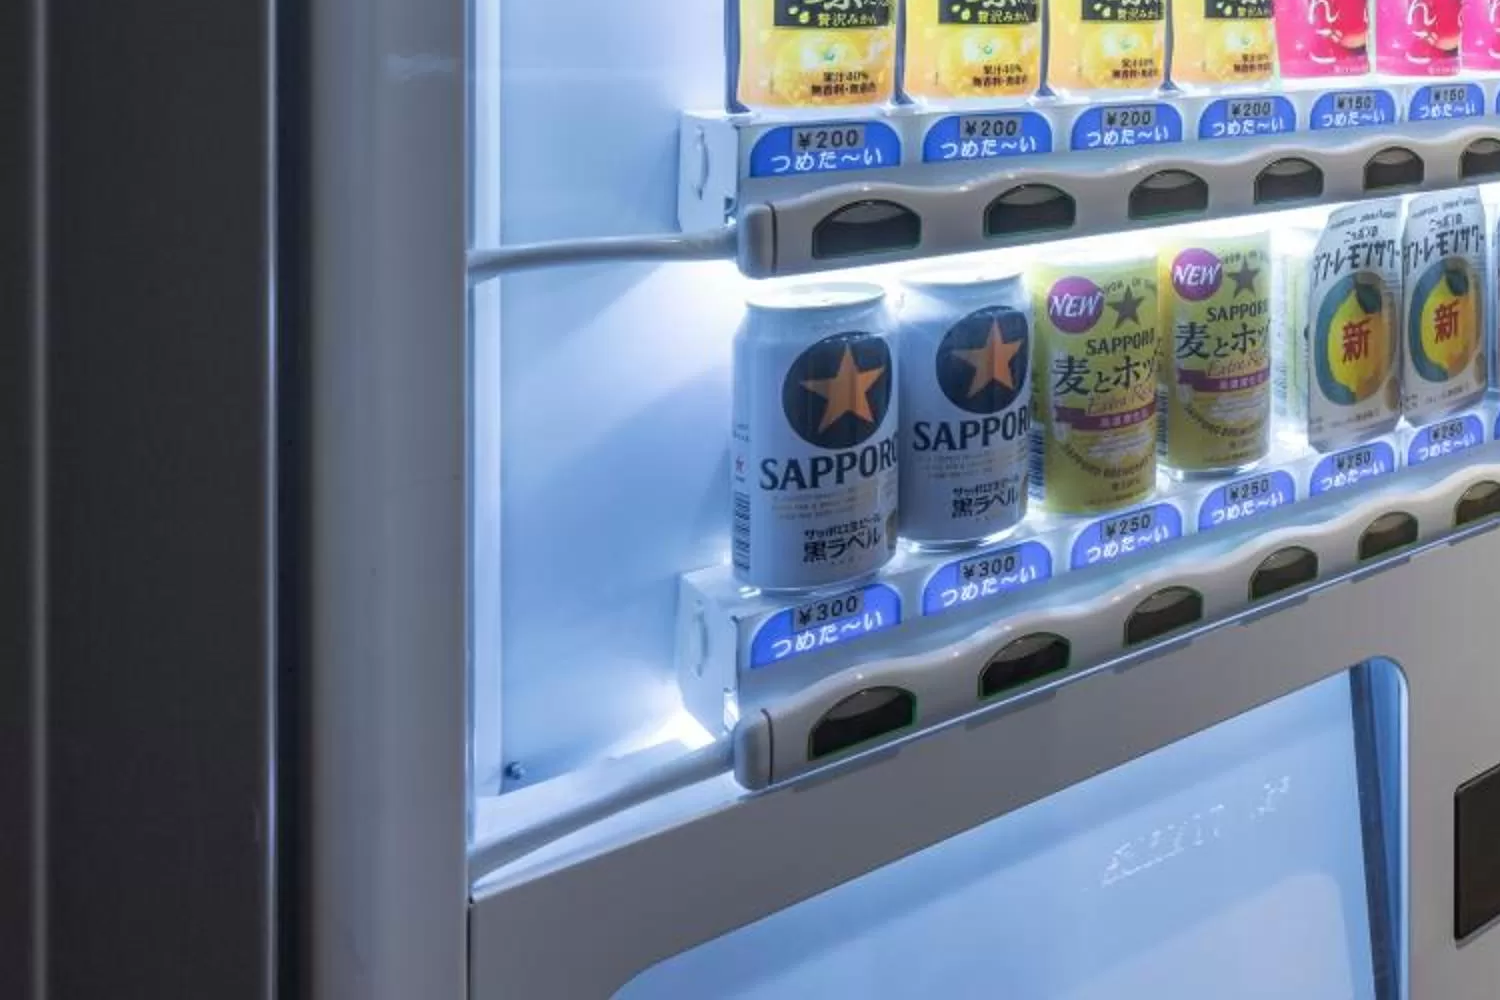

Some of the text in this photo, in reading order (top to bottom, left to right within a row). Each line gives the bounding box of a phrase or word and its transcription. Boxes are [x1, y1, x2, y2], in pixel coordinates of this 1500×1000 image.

[1107, 110, 1151, 126] ¥200
[1232, 101, 1271, 117] ¥200
[798, 128, 859, 149] ¥200
[965, 119, 1017, 136] ¥200
[1174, 261, 1223, 286] NEW
[1050, 295, 1103, 318] NEW
[1434, 300, 1460, 345] 新
[1342, 317, 1371, 364] 新
[912, 403, 1030, 453] SAPPOR
[1230, 478, 1269, 500] ¥250
[952, 486, 1018, 519] 黒ラベル
[1106, 513, 1150, 538] ¥250
[803, 527, 882, 563] 黒ラベル
[963, 555, 1016, 580] ¥300
[799, 595, 859, 626] ¥300
